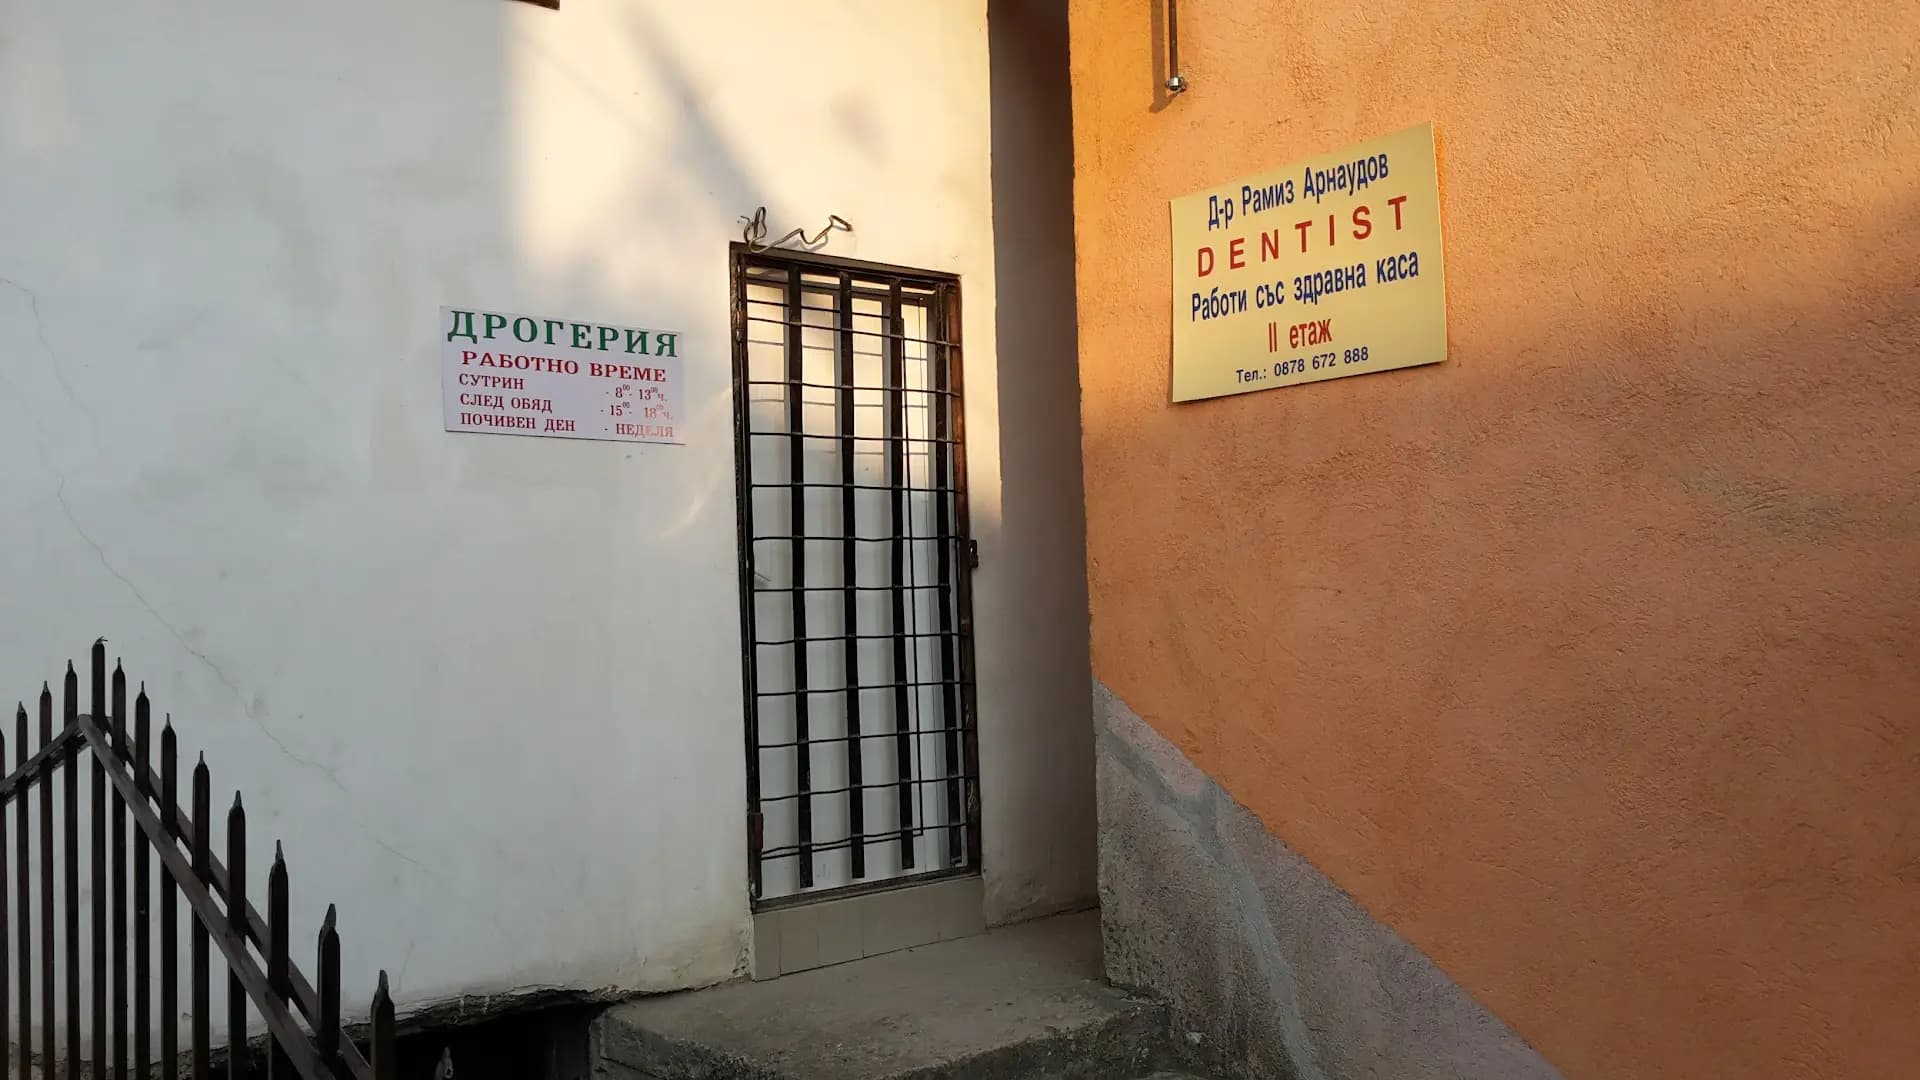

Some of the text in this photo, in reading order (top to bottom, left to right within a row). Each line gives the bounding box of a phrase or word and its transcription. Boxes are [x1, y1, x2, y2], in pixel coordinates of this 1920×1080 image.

[1208, 153, 1389, 231] Д-р Рамиз Арнаудов
[1197, 195, 1407, 277] DENTIST
[1191, 251, 1419, 322] Работи със здравна каса
[447, 310, 678, 358] ДРОГЕРИЯ
[1289, 318, 1333, 350] етаж
[458, 373, 524, 390] СУТРИН
[461, 350, 666, 382] РАБОТНО ВРЕМЕ
[1236, 346, 1369, 384] Тел.: 0878 672 888
[460, 393, 505, 411] СЛЕД
[511, 397, 553, 414] ОБЯД
[460, 412, 536, 430] ПОЧИВЕН
[544, 418, 576, 433] ДЕН
[616, 423, 673, 438] НЕДЕЛЯ
